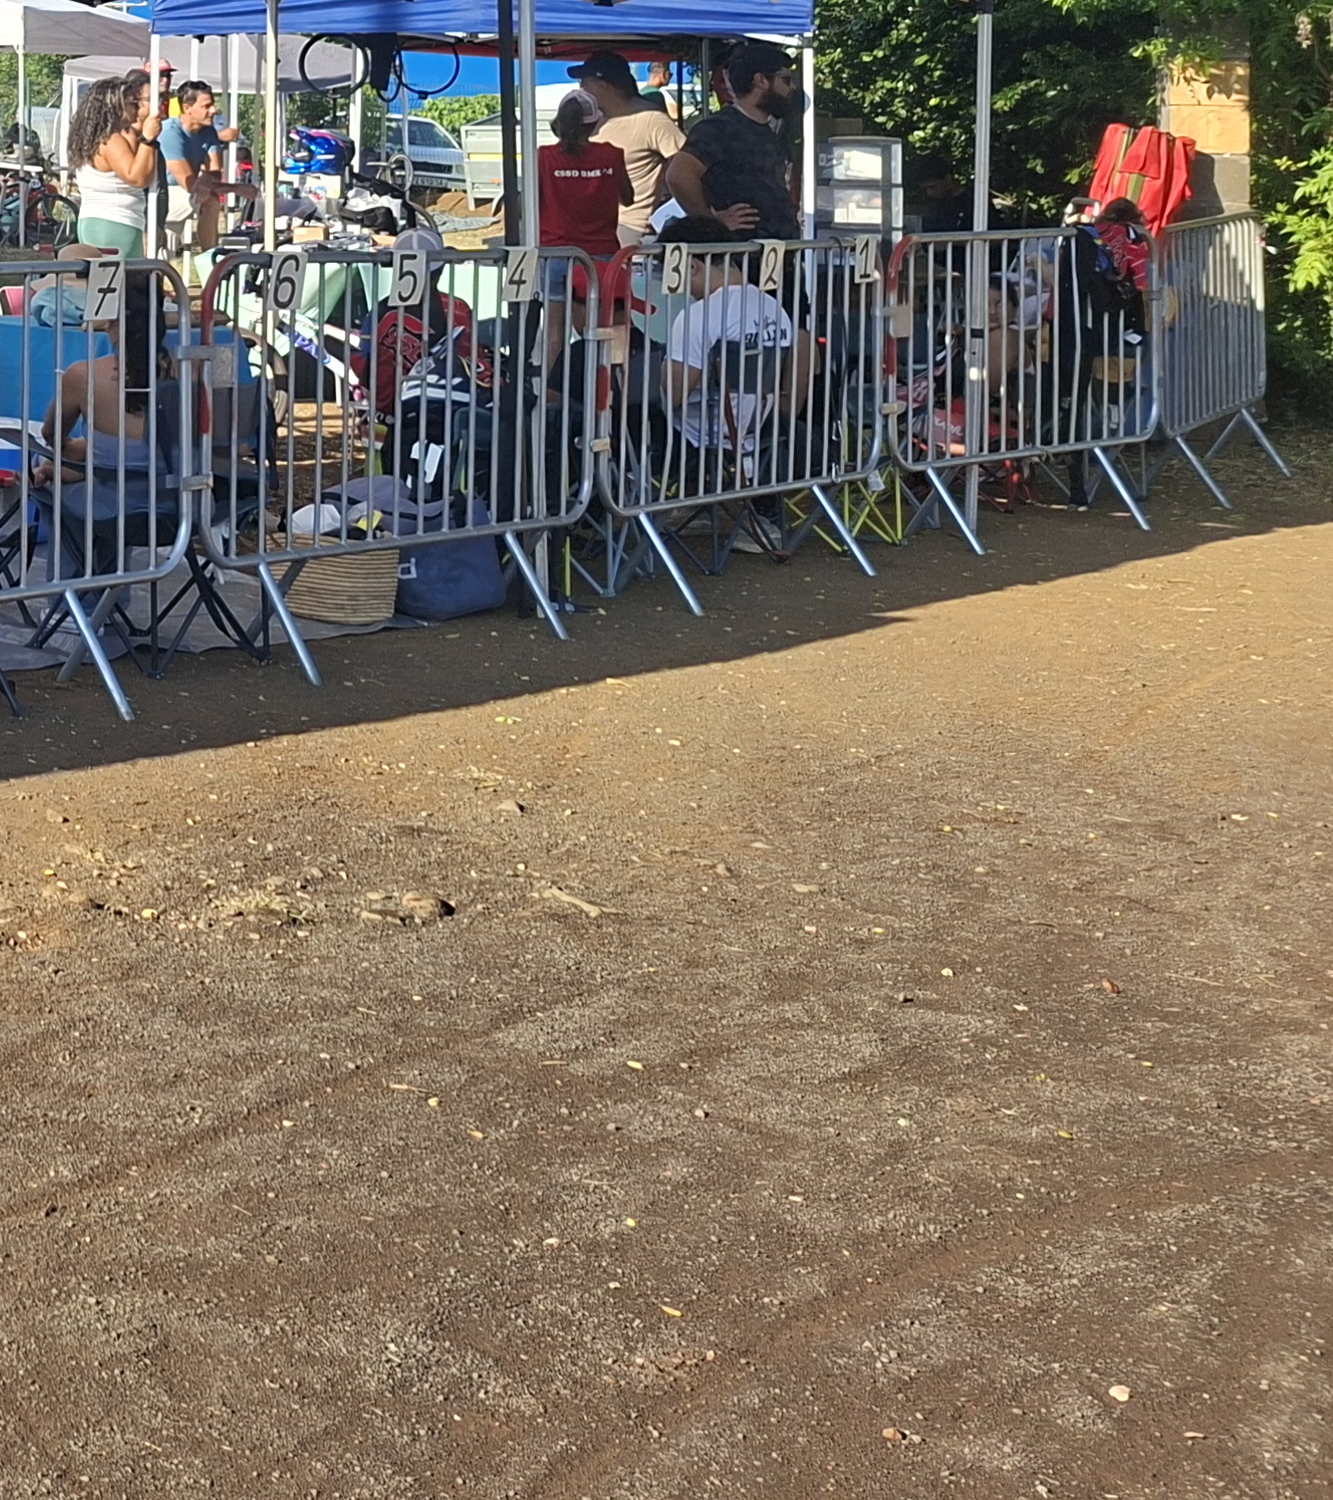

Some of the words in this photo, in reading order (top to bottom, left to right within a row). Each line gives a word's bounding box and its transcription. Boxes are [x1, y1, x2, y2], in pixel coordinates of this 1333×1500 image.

[273, 253, 301, 310] 6
[397, 253, 419, 303] 5
[507, 250, 528, 299] 4
[666, 244, 683, 295] 3
[763, 245, 779, 288] 2
[857, 236, 872, 280] 1
[94, 261, 120, 318] 7
